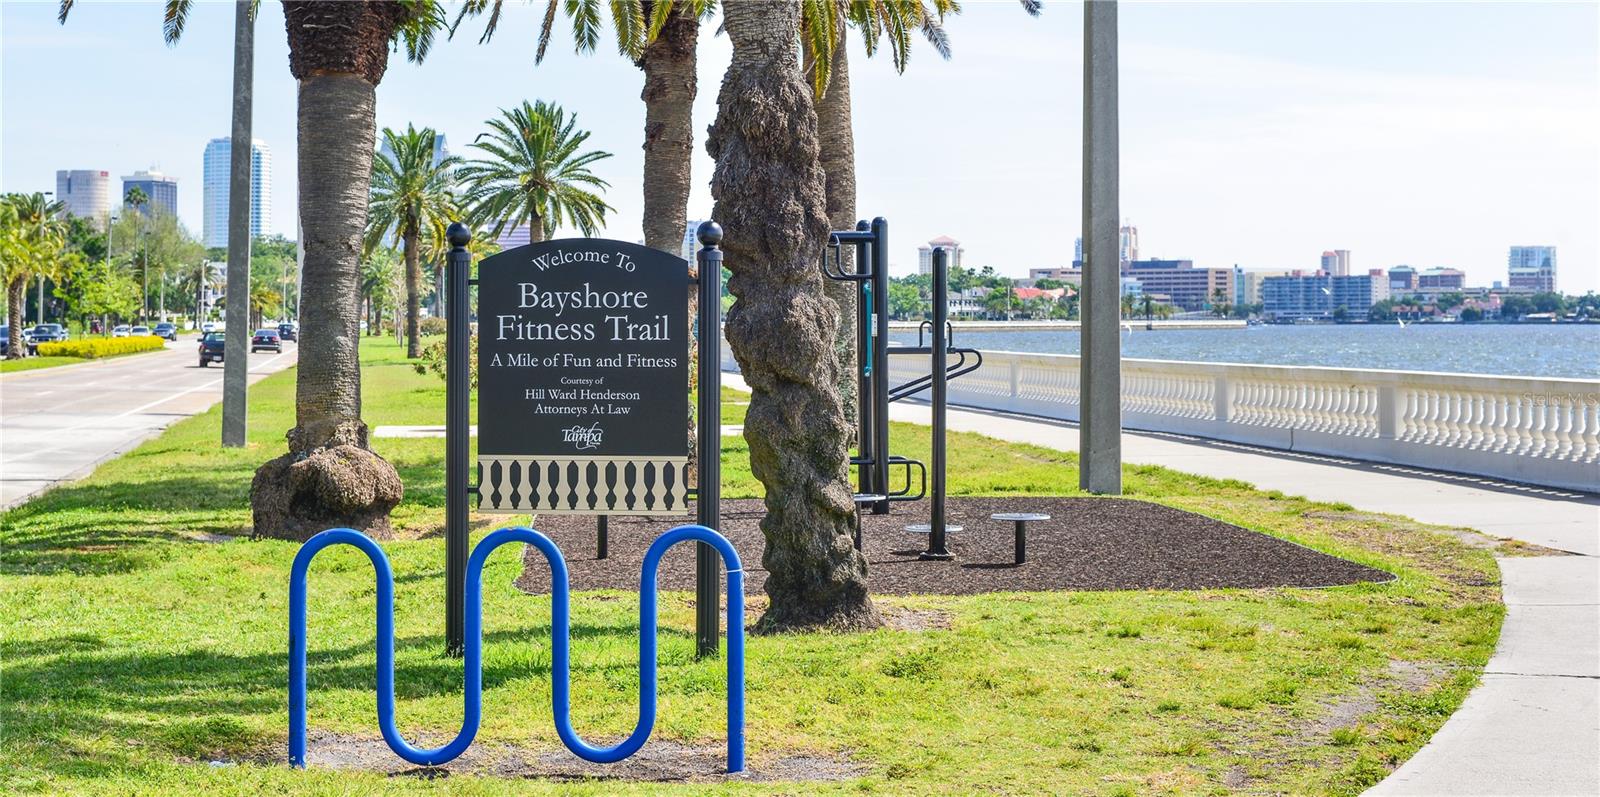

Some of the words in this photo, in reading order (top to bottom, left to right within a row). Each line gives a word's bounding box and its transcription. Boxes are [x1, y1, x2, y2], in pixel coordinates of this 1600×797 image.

[532, 250, 610, 272] Welcome
[615, 252, 636, 272] To
[518, 283, 648, 316] Bayshore
[496, 315, 595, 341] Fitness
[604, 315, 671, 341] Trail
[490, 353, 503, 367] A
[507, 353, 538, 367] Mile
[543, 353, 560, 367] of
[563, 354, 591, 367] Fun
[596, 354, 622, 367] and
[627, 354, 677, 368] Fitness
[560, 376, 594, 386] Courtesy
[594, 376, 604, 385] of
[525, 389, 546, 400] Hill
[548, 389, 577, 400] Ward
[580, 389, 640, 400] Henderson
[534, 403, 588, 417] Attorneys
[591, 403, 605, 414] At
[608, 403, 631, 414] Law
[561, 429, 604, 446] Tampa
